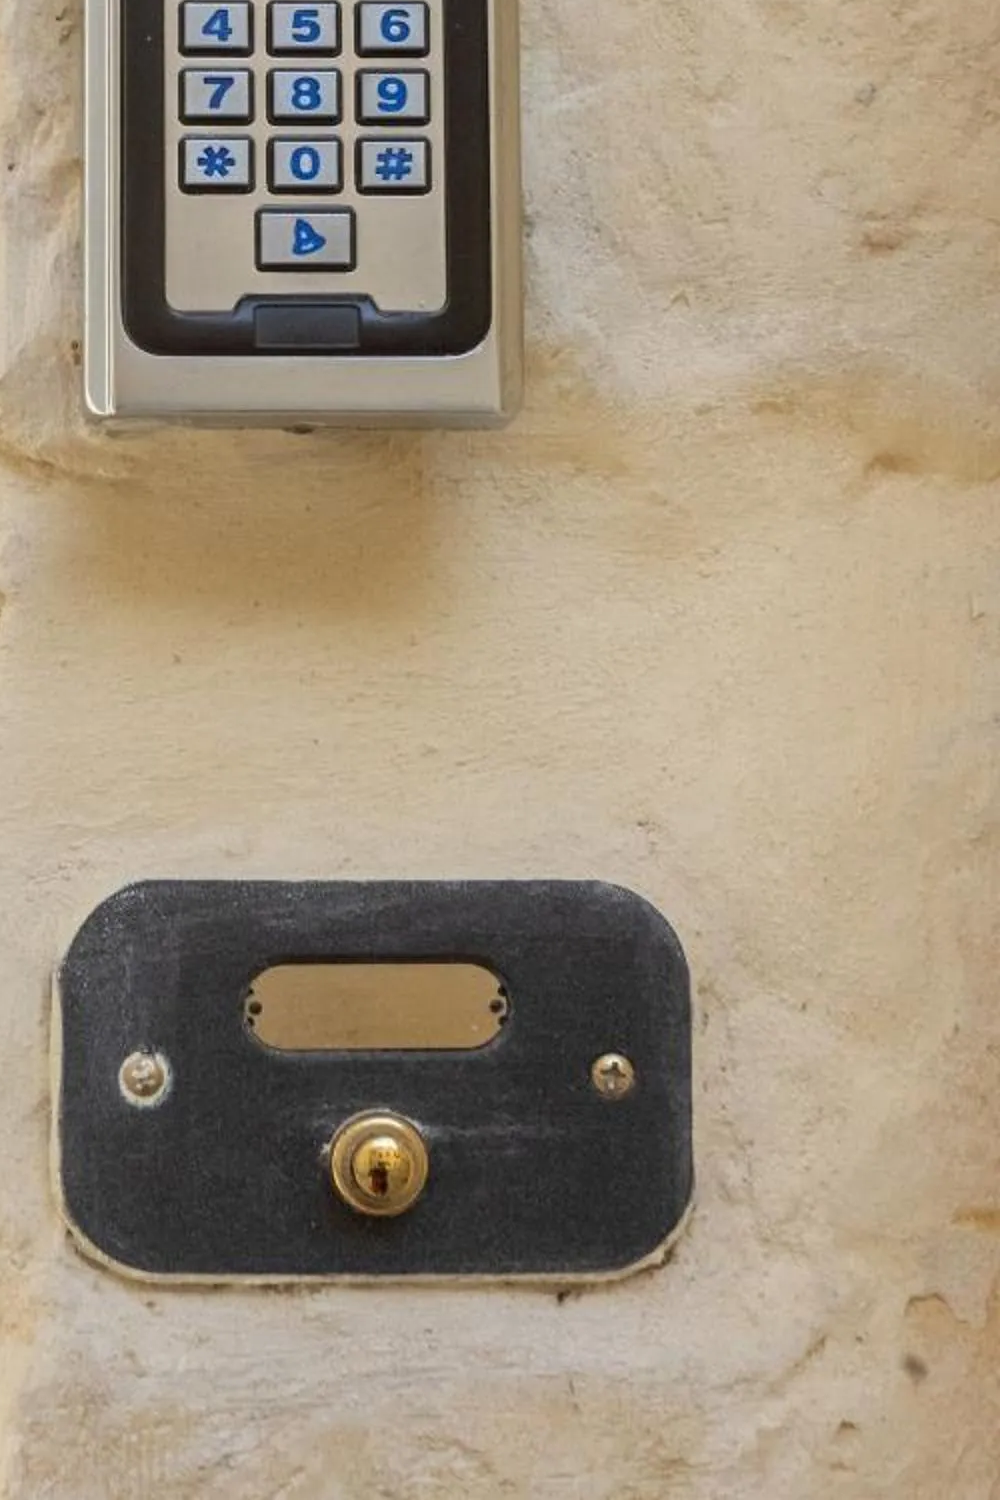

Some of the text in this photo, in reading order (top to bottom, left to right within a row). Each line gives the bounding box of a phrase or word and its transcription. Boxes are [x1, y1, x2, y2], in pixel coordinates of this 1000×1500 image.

[202, 9, 411, 43] 4 5 6
[203, 76, 407, 112] 7 8 9
[290, 146, 321, 181] 0
[375, 147, 412, 181] #
